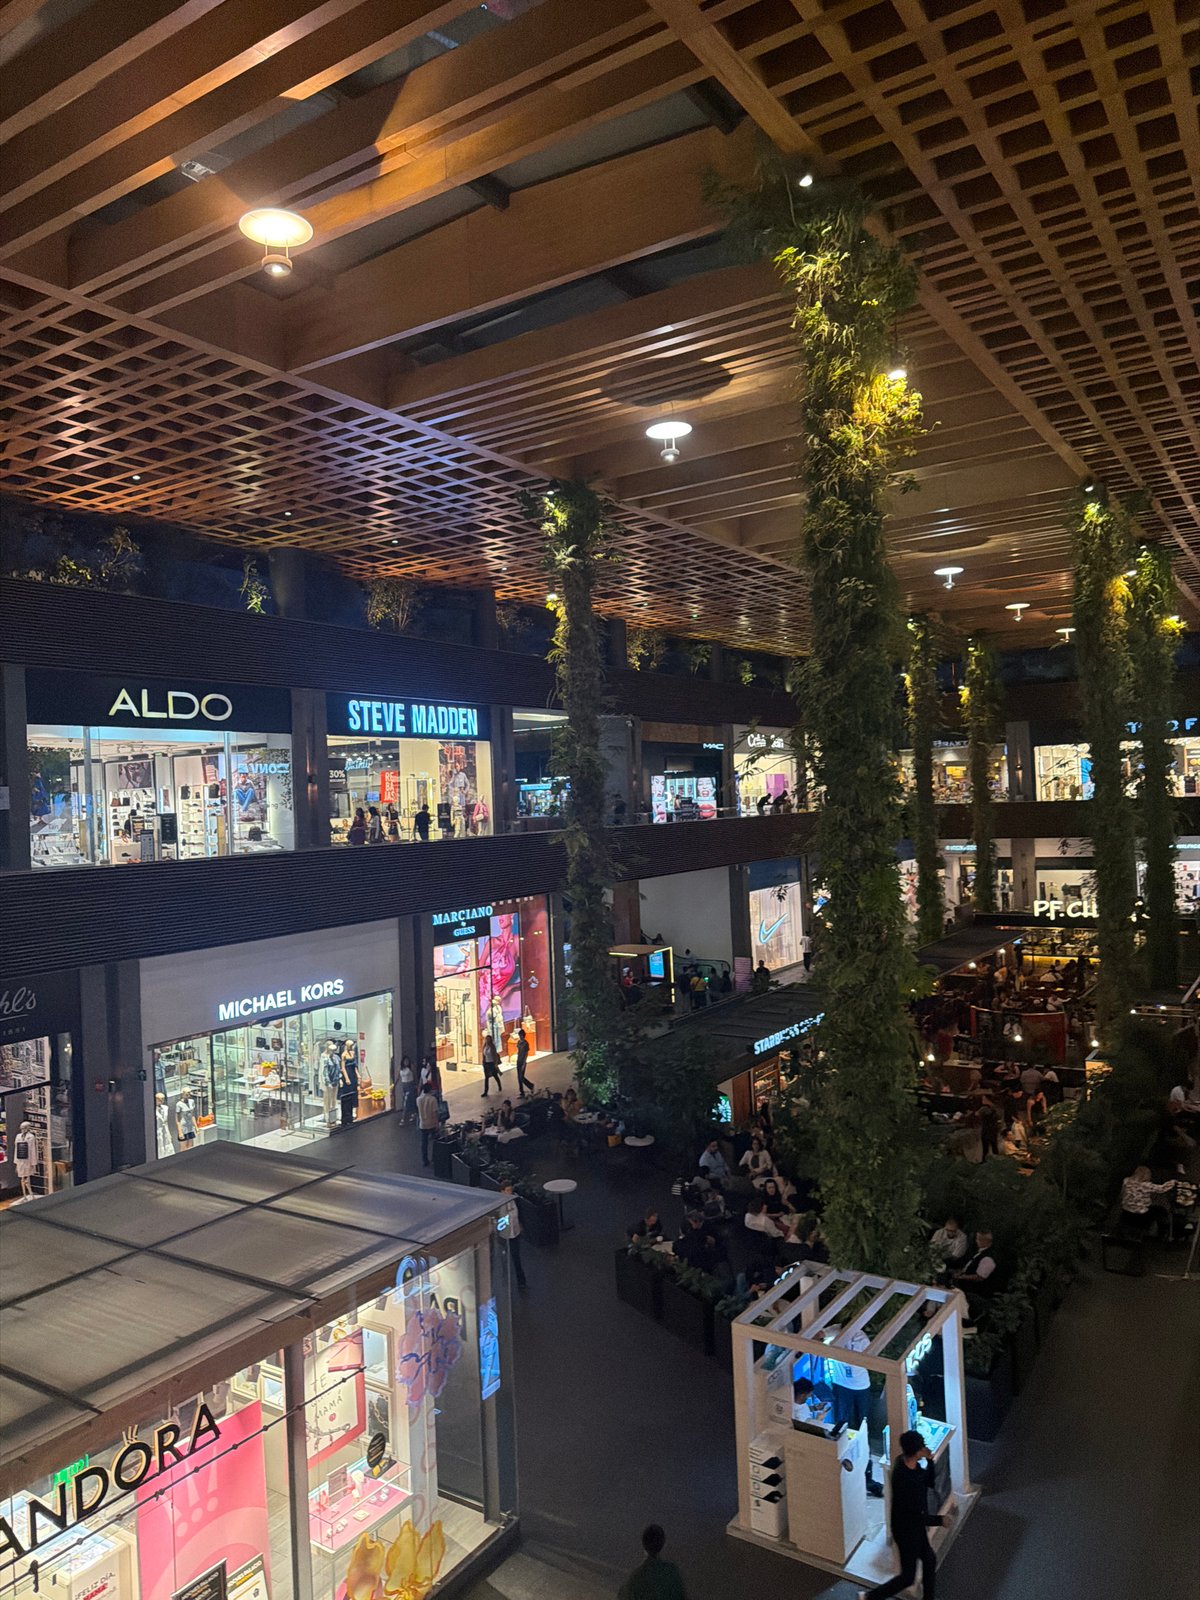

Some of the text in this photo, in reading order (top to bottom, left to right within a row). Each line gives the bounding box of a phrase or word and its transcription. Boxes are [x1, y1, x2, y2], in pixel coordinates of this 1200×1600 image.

[108, 688, 233, 721] ALDO
[348, 699, 478, 735] STEVE MADDEN
[329, 770, 346, 779] 30%
[432, 905, 493, 926] MARCIANO
[453, 925, 476, 937] GUESS
[218, 979, 344, 1020] MICHAEL KORS
